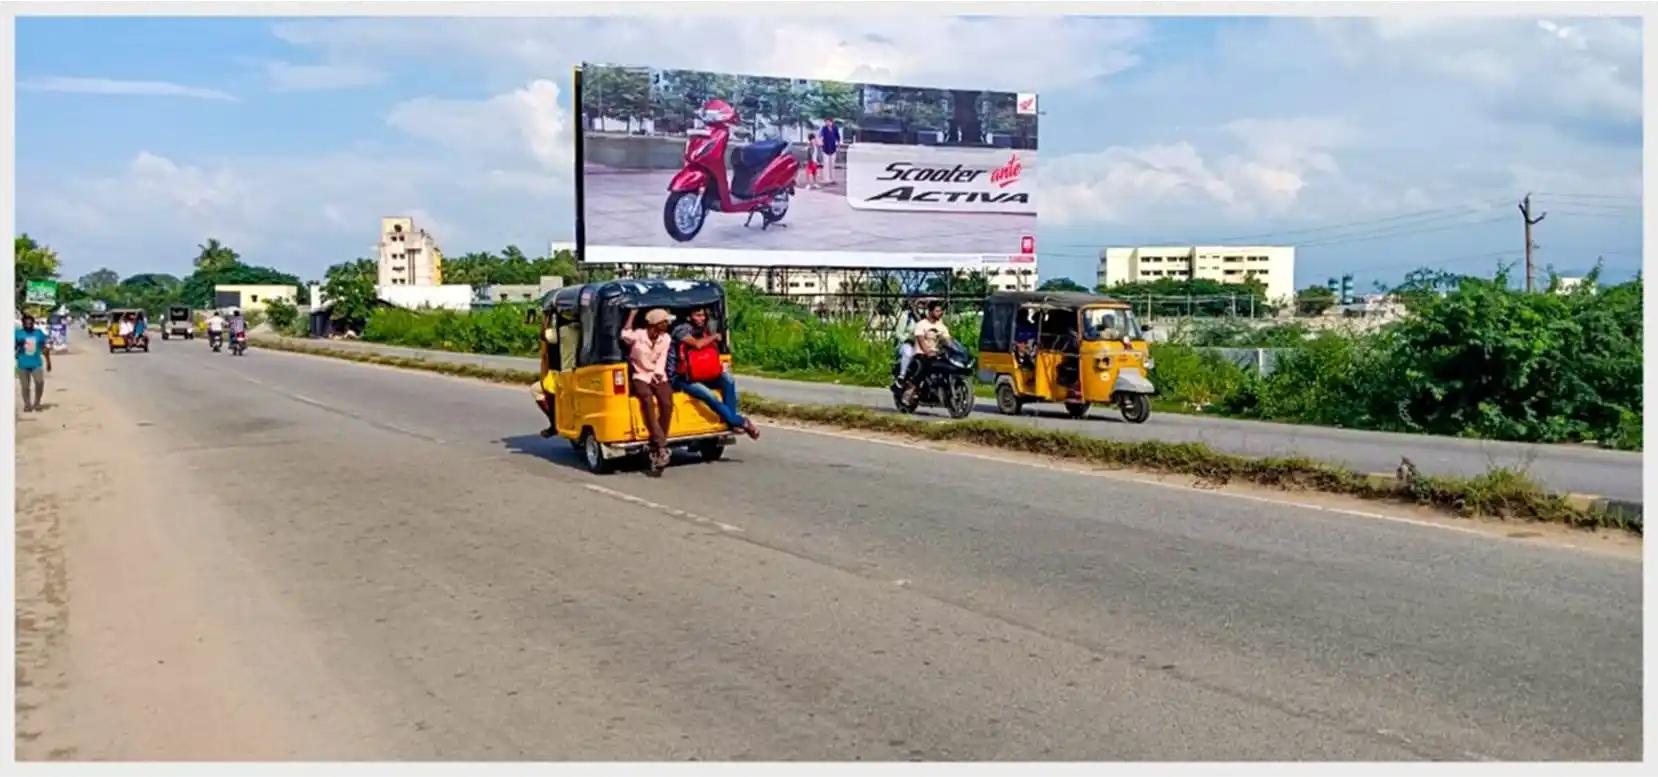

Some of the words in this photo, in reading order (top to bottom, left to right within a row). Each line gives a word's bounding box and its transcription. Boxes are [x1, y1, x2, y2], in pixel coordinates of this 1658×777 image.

[876, 162, 987, 183] Scooter
[990, 154, 1022, 184] ante
[864, 186, 1029, 204] ACTIVA
